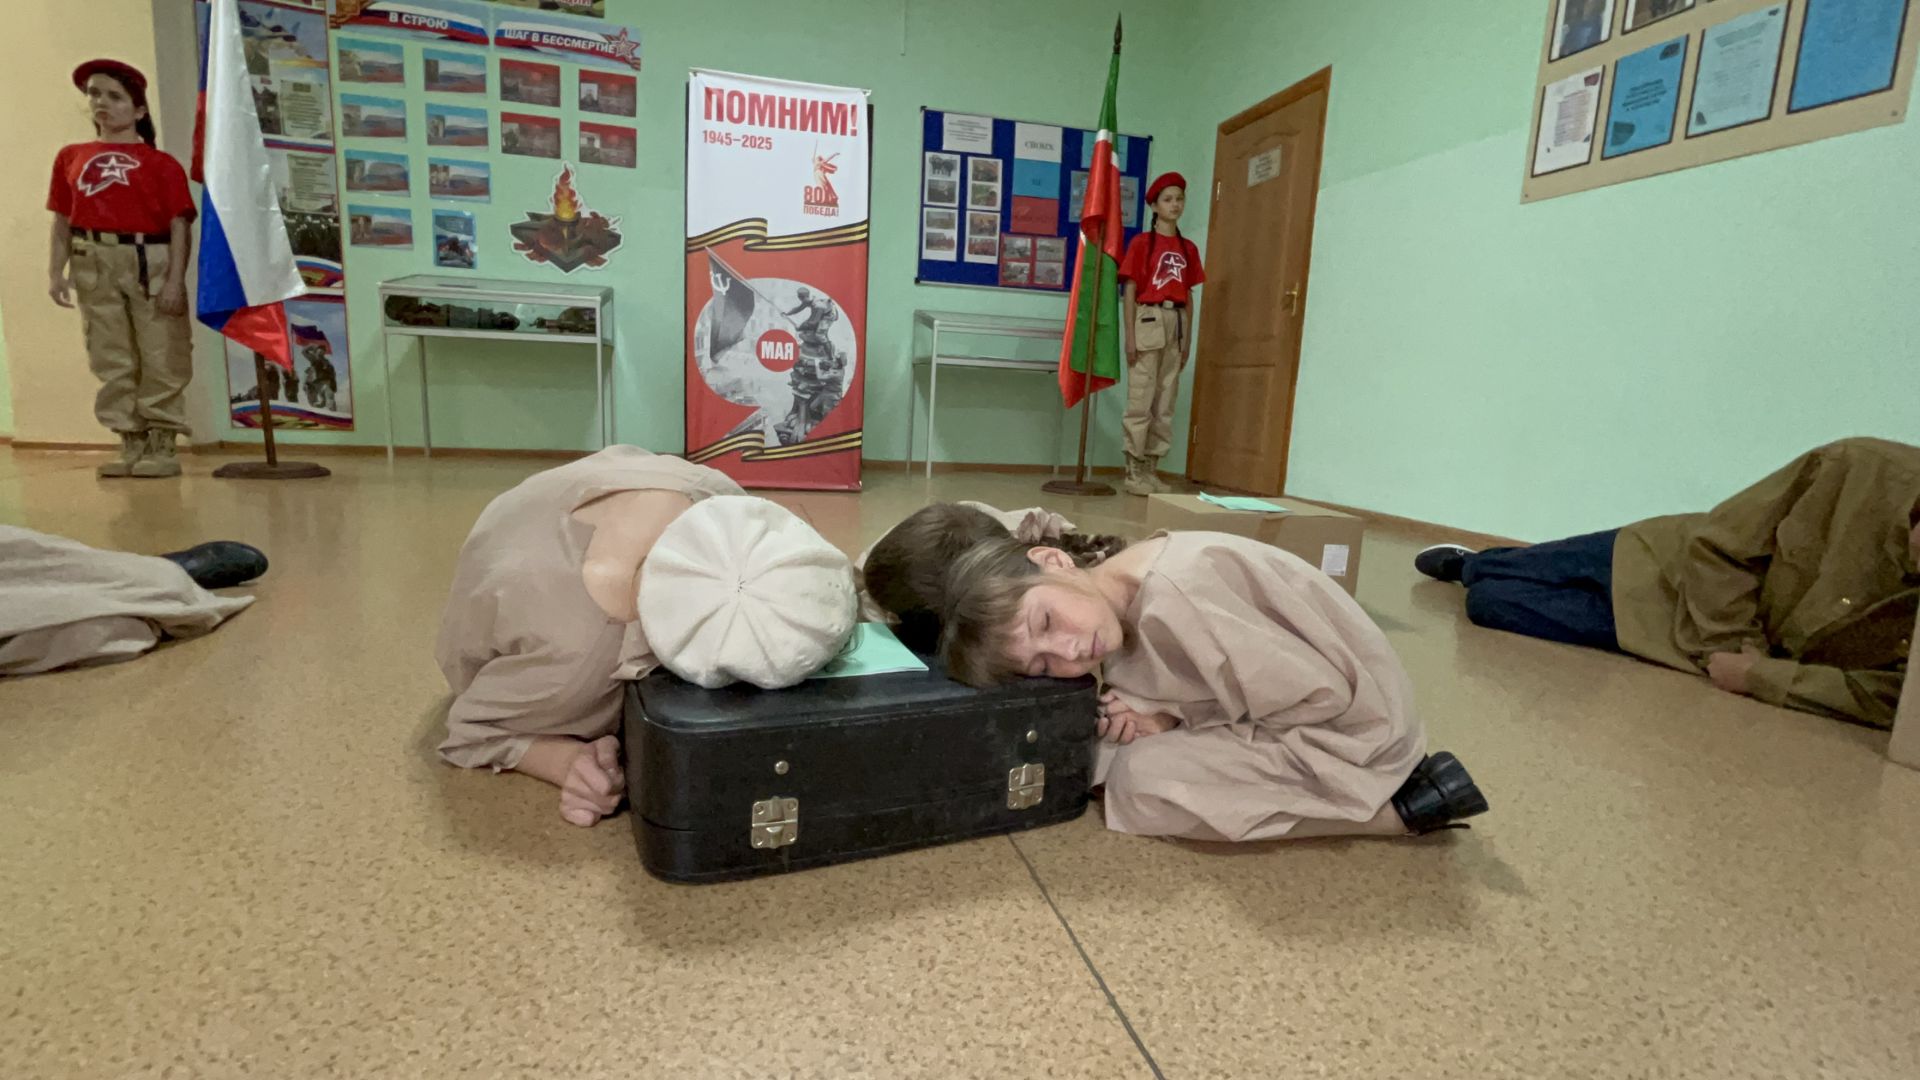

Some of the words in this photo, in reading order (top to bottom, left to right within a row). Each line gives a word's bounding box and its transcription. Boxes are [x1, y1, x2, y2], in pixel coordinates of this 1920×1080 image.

[388, 12, 398, 23] В
[402, 14, 449, 30] СТРОЮ
[503, 28, 528, 40] ШАГ
[531, 32, 540, 42] В
[542, 34, 617, 54] БЕССМЕРТИЕ
[704, 87, 857, 136] ПОМНИМ!
[803, 205, 839, 217] ПОБЕДА!
[761, 341, 794, 360] МАЯ
